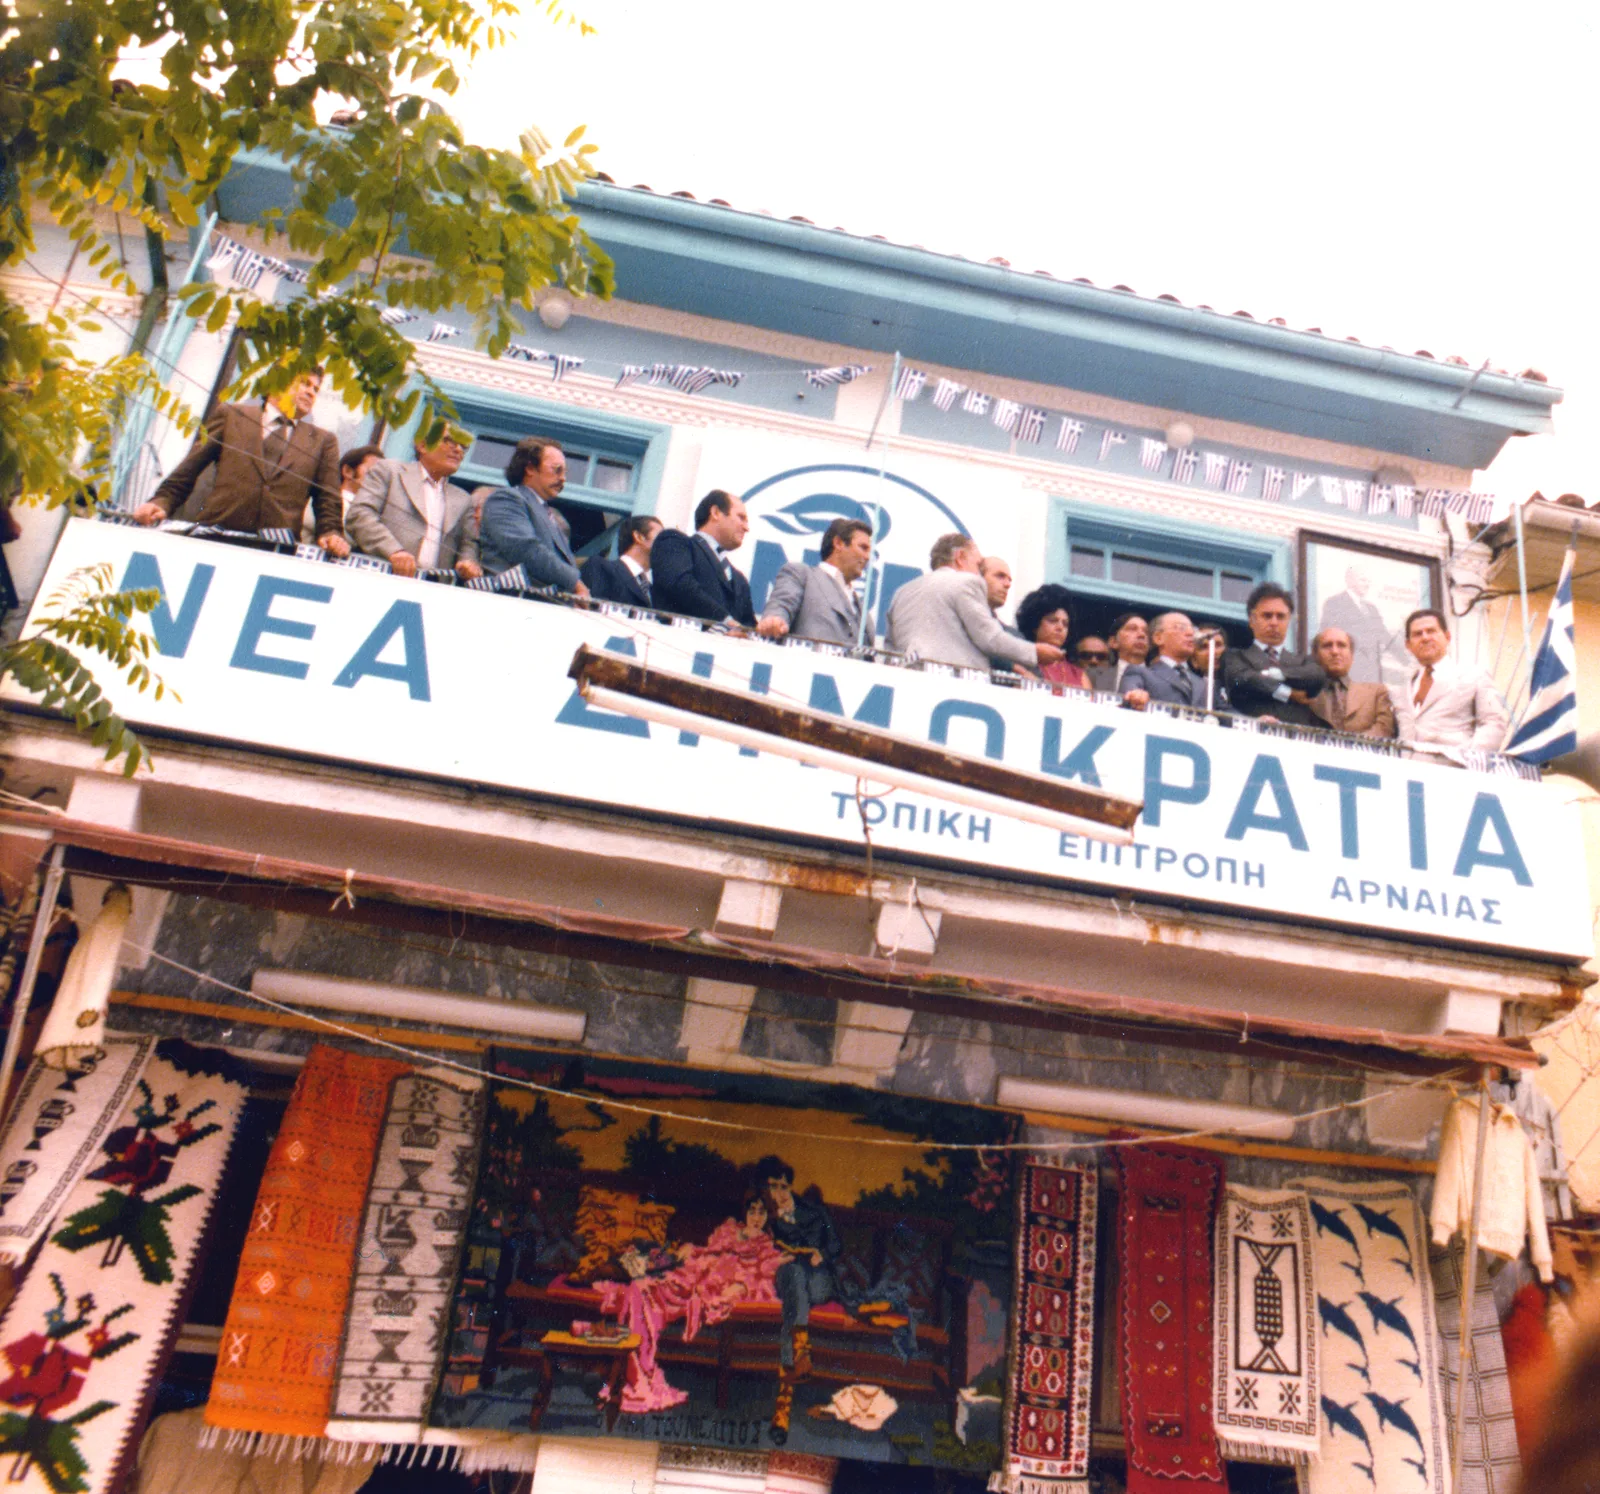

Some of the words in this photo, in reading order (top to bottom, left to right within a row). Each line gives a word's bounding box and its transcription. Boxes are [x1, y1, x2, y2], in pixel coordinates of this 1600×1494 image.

[106, 551, 432, 703] ΝΕΑ
[831, 791, 991, 843] ΤΟΠΙΚΗ
[1059, 831, 1265, 888] ΕΠΙΤΡΟΠΗ
[1330, 876, 1502, 925] ΑΡΝΑΙΑΣ
